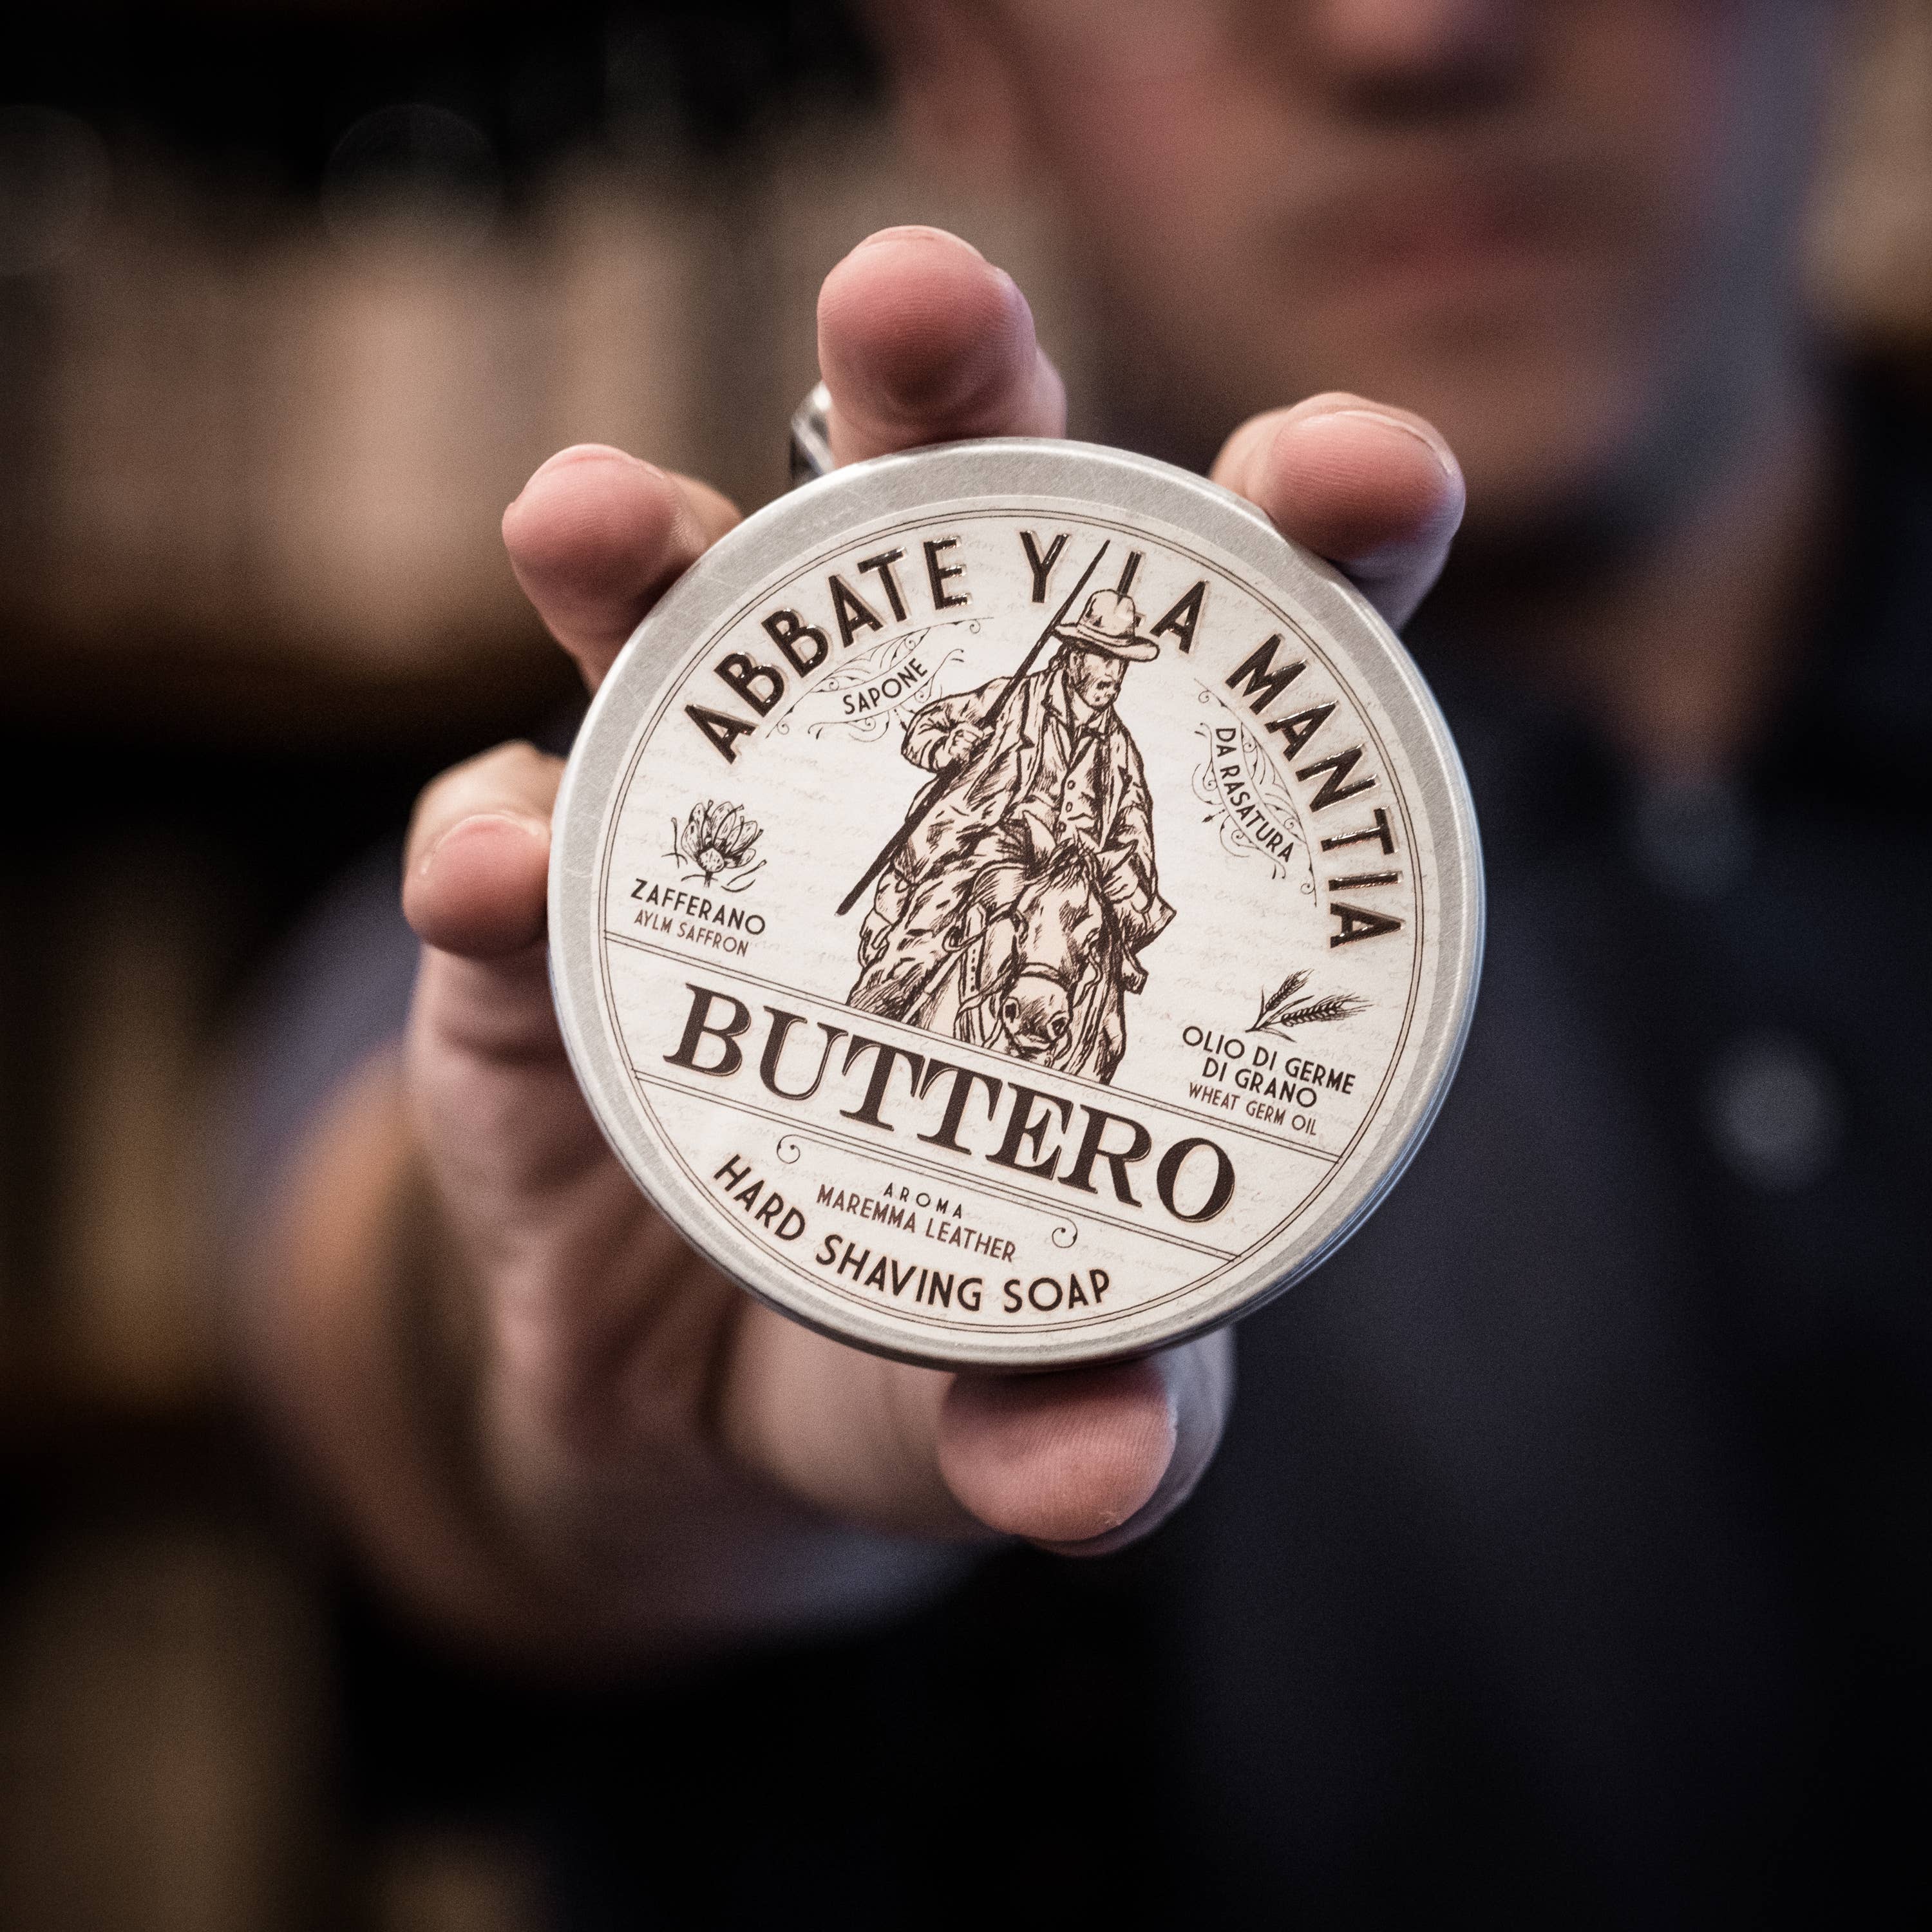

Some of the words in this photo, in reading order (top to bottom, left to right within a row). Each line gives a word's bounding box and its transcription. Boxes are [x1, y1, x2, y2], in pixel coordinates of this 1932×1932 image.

[843, 658, 927, 715] SAPONE
[684, 535, 971, 764] ABBATE
[1019, 531, 1070, 603] Y
[1226, 632, 1405, 948] MANTIA
[1215, 728, 1236, 757] DA
[1220, 766, 1294, 862] RASATURA
[630, 878, 765, 934] ZAFFERANO
[634, 909, 672, 934] AYLM
[677, 922, 749, 956] SAFFRON
[1182, 1025, 1244, 1059] OLIO
[1253, 1046, 1277, 1070] DI
[1284, 1057, 1356, 1095] GERME
[1202, 1057, 1227, 1081] DI
[1235, 1068, 1317, 1108] GRANO
[663, 983, 1235, 1222] BUTTERO
[1189, 1082, 1240, 1110] WHEAT
[1246, 1101, 1285, 1126] GERM
[1291, 1114, 1316, 1136] OIL
[816, 1184, 915, 1233] MAREMMA
[925, 1222, 1016, 1262] LEATHER
[884, 1182, 963, 1218] AROMA
[714, 1154, 805, 1241] HARD
[815, 1234, 981, 1311] SHAVING
[1005, 1269, 1109, 1313] SOAP
